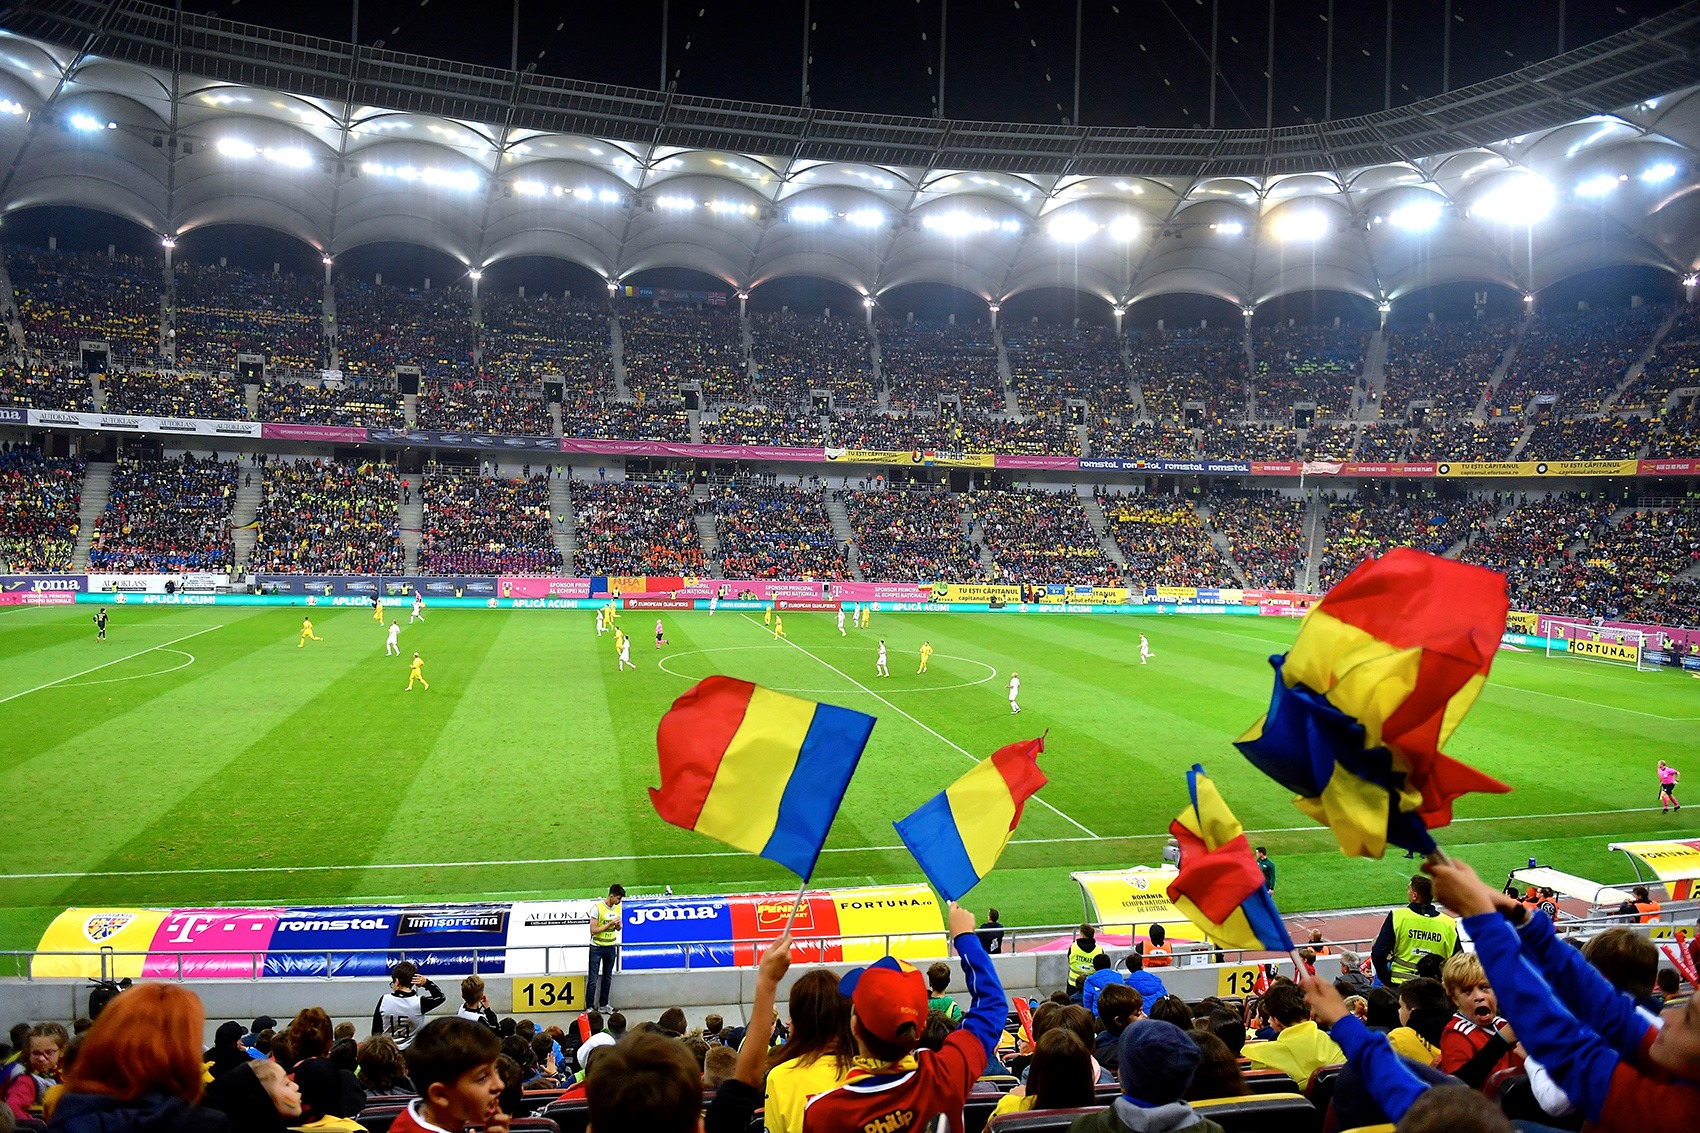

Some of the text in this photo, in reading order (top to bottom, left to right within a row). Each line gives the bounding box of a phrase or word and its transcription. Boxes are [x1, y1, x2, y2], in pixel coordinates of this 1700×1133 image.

[143, 593, 216, 604] APLICĂ ACUM!
[512, 598, 577, 608] APLICĂ ACUM!
[894, 602, 921, 611] APLICĂ
[526, 911, 590, 920] AUTOKLA
[1408, 929, 1442, 942] STEWARD
[1226, 971, 1260, 994] 13
[522, 982, 574, 1006] 134
[390, 1015, 409, 1038] 15
